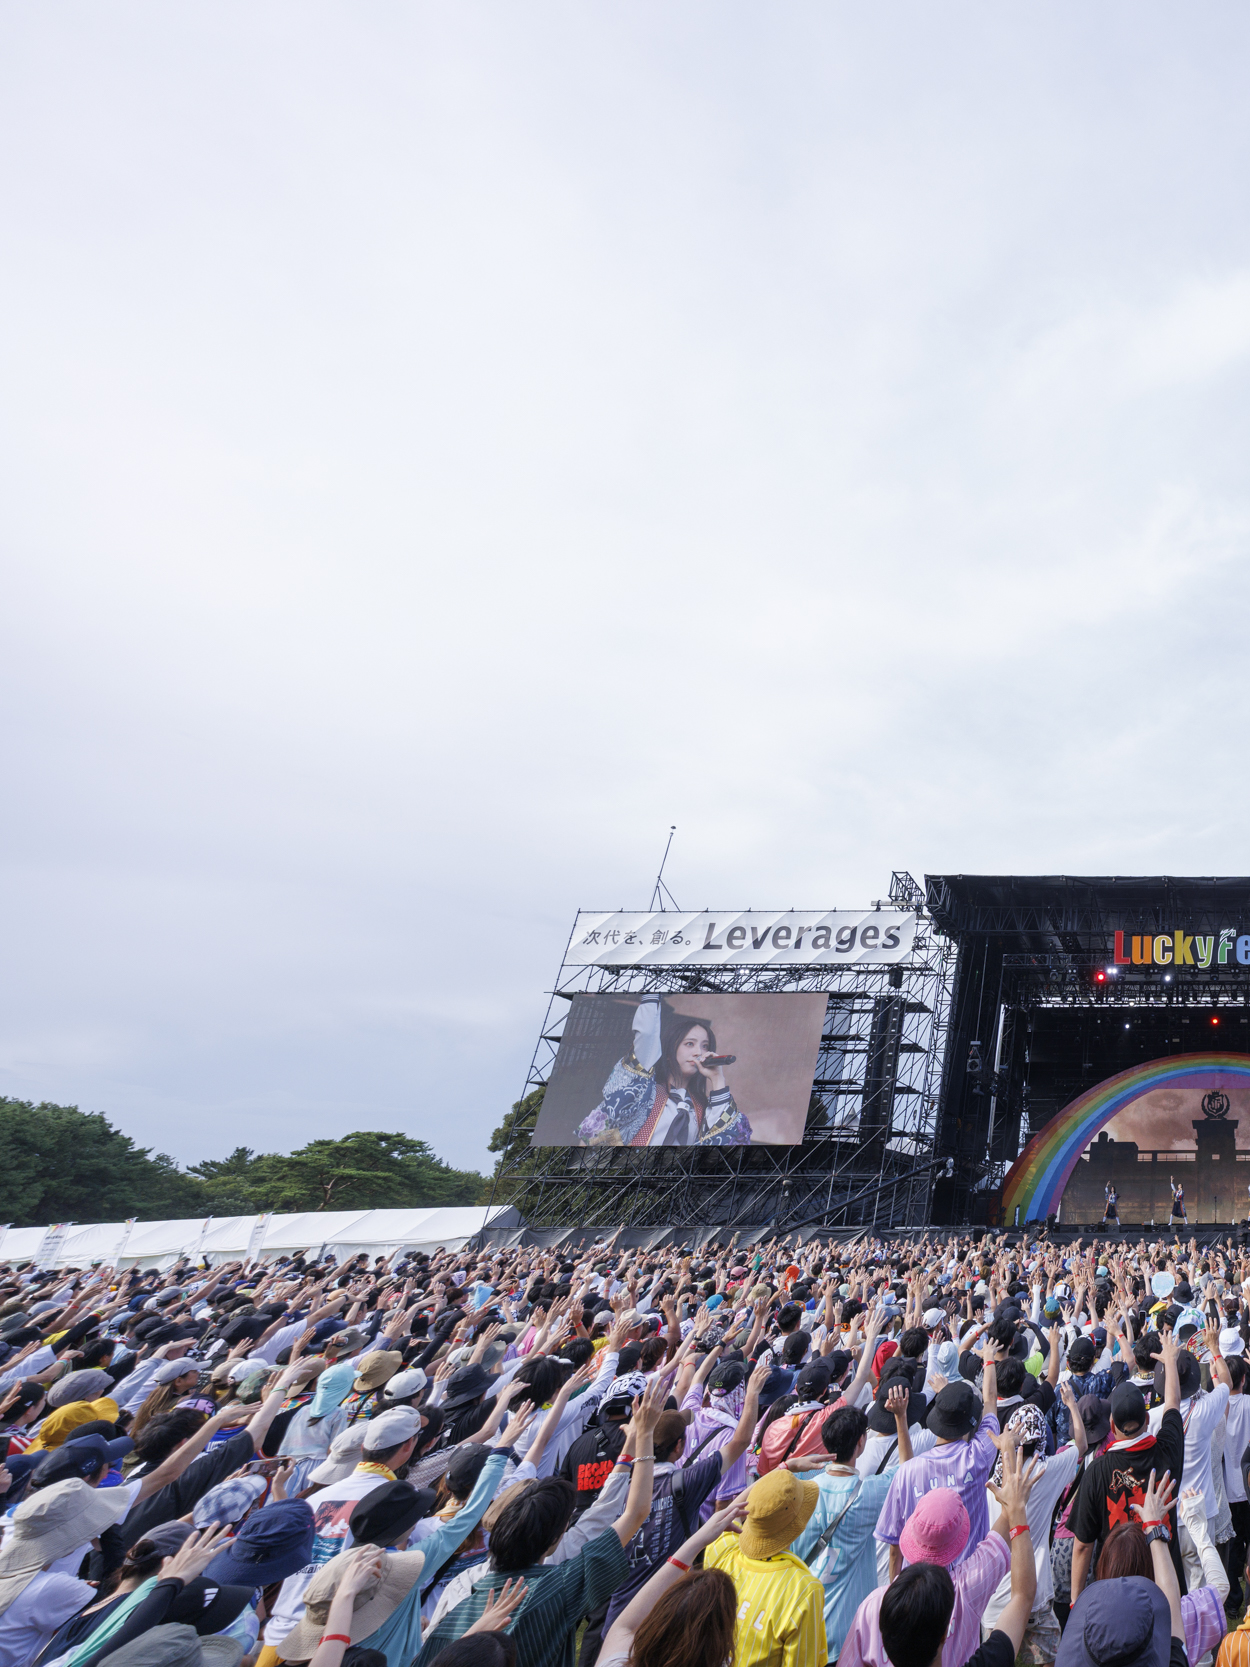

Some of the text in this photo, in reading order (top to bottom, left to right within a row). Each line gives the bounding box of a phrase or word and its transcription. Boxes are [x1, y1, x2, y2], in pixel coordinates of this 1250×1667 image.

[582, 928, 692, 946] 次代を、創る。
[702, 922, 901, 952] Leverages
[913, 1470, 974, 1498] LUNA
